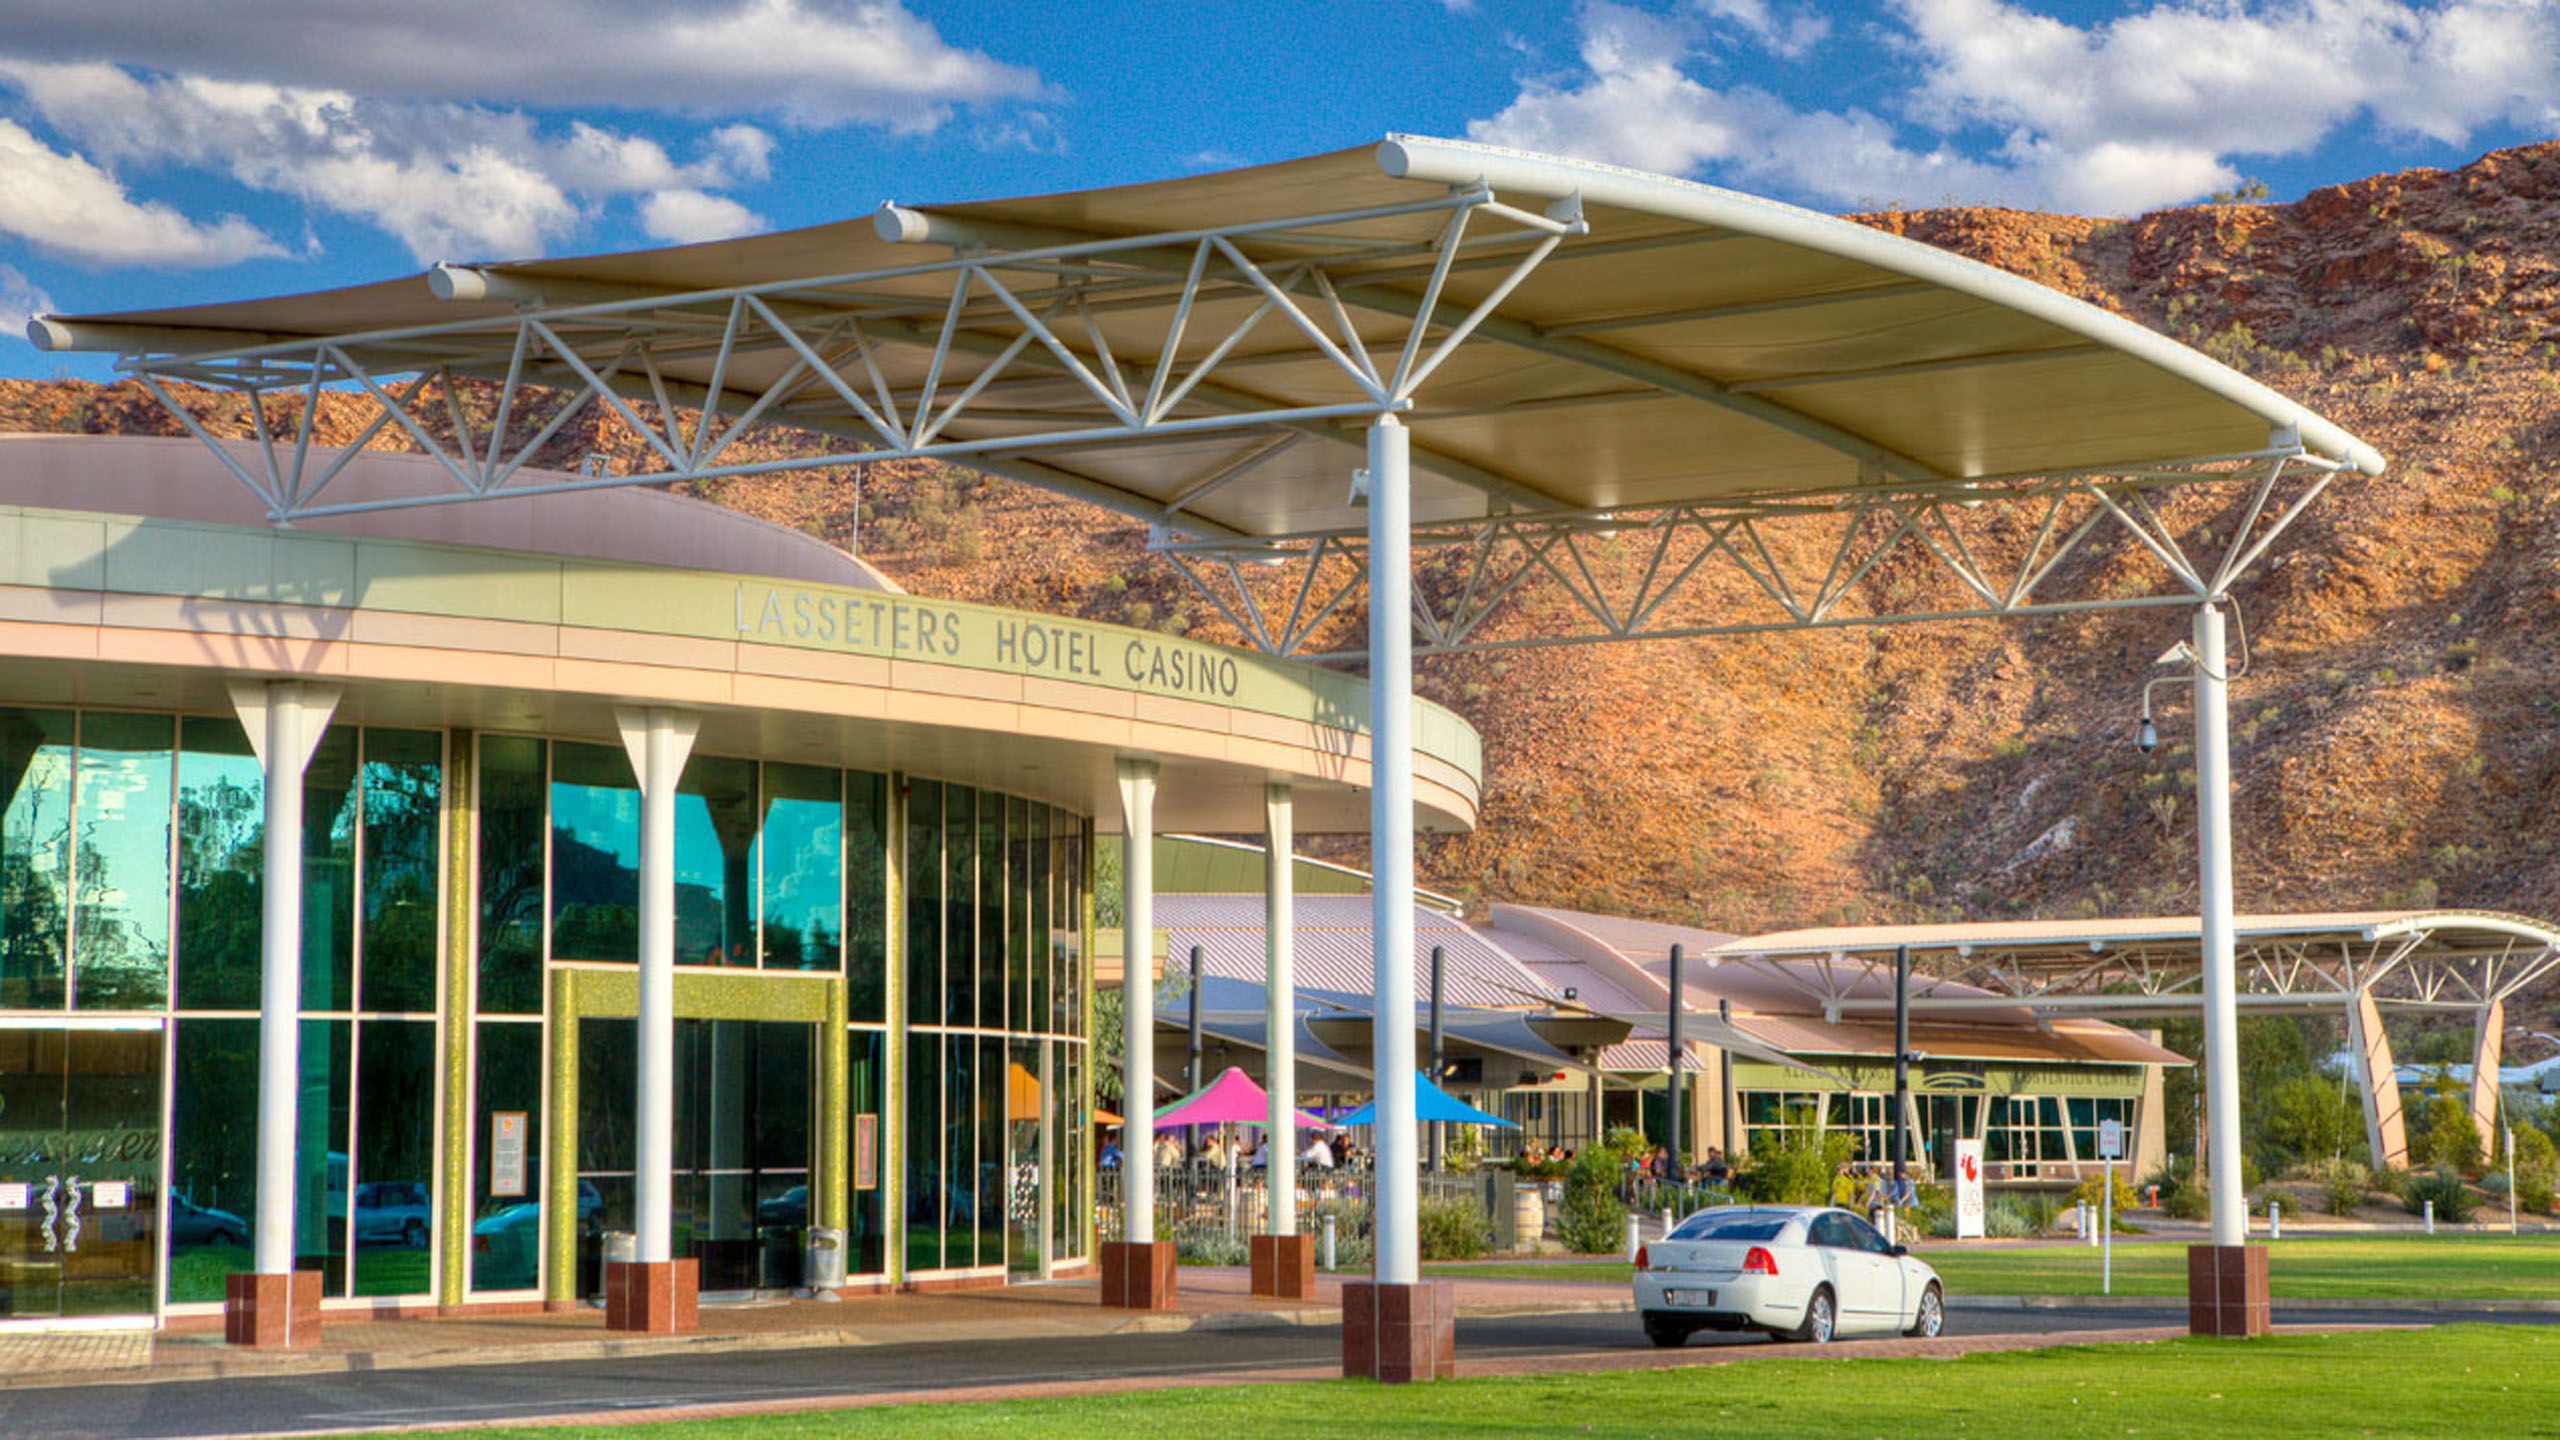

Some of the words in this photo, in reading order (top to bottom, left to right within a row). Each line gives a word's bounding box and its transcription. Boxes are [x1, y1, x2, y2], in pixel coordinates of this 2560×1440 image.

[735, 580, 960, 656] LASSETERS
[997, 619, 1102, 678] HOTEL
[1124, 640, 1238, 698] CASINO
[2016, 1066, 2092, 1085] ONVENTION
